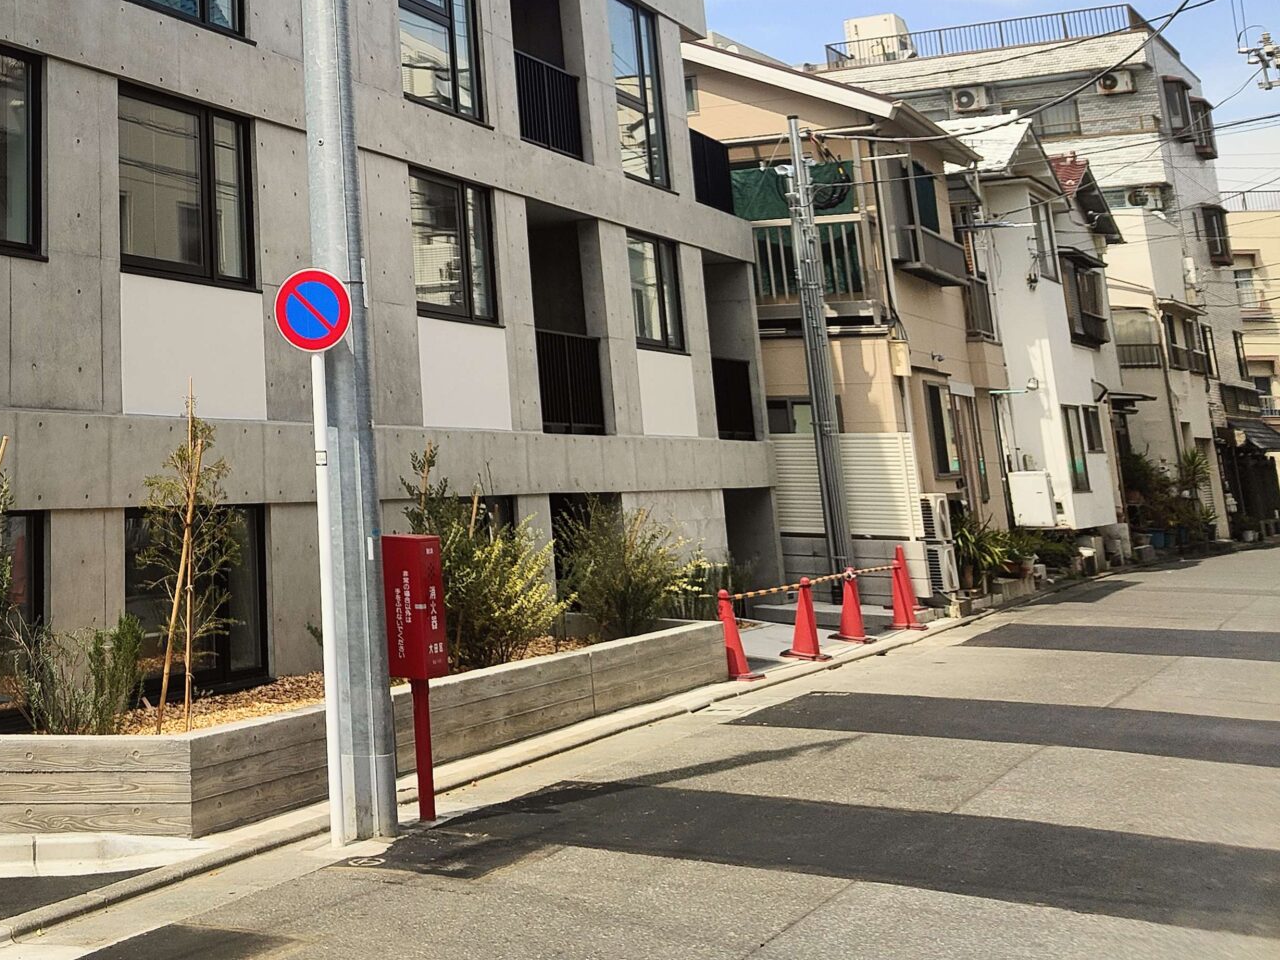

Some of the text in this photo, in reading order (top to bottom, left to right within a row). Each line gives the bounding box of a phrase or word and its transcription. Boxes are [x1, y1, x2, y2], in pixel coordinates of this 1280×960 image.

[428, 585, 438, 630] 消火器
[428, 642, 444, 654] 大田区
